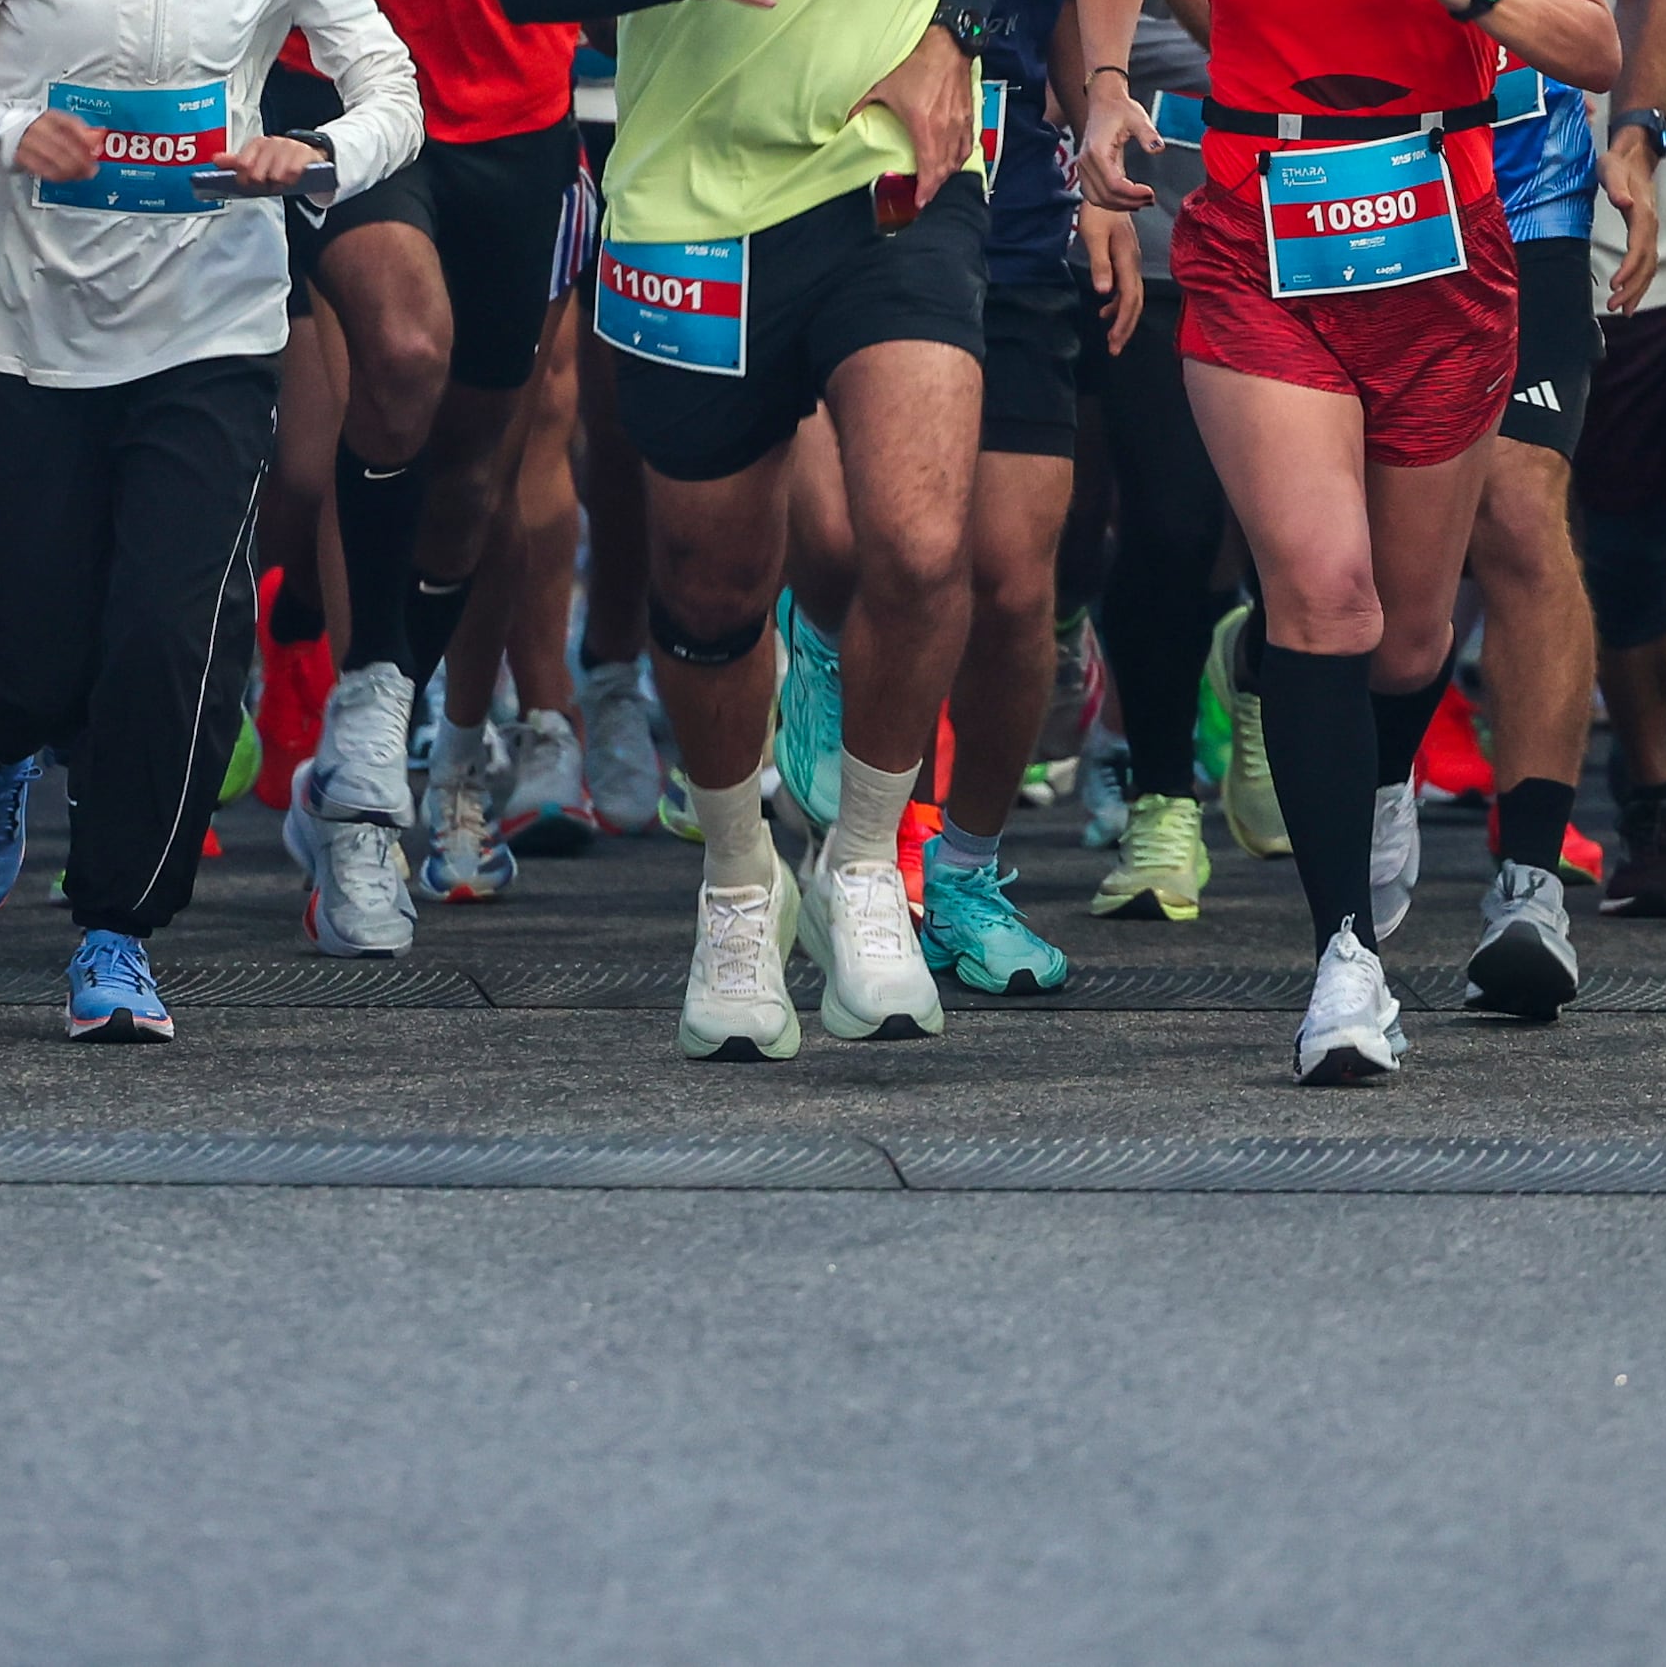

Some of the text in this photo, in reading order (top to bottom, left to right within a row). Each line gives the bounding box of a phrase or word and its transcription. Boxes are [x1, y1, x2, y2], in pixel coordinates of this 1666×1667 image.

[105, 132, 197, 163] 0805
[1391, 154, 1412, 166] YAS
[1282, 166, 1326, 178] ETHARA
[1306, 190, 1417, 233] 10890
[612, 263, 703, 311] 11001
